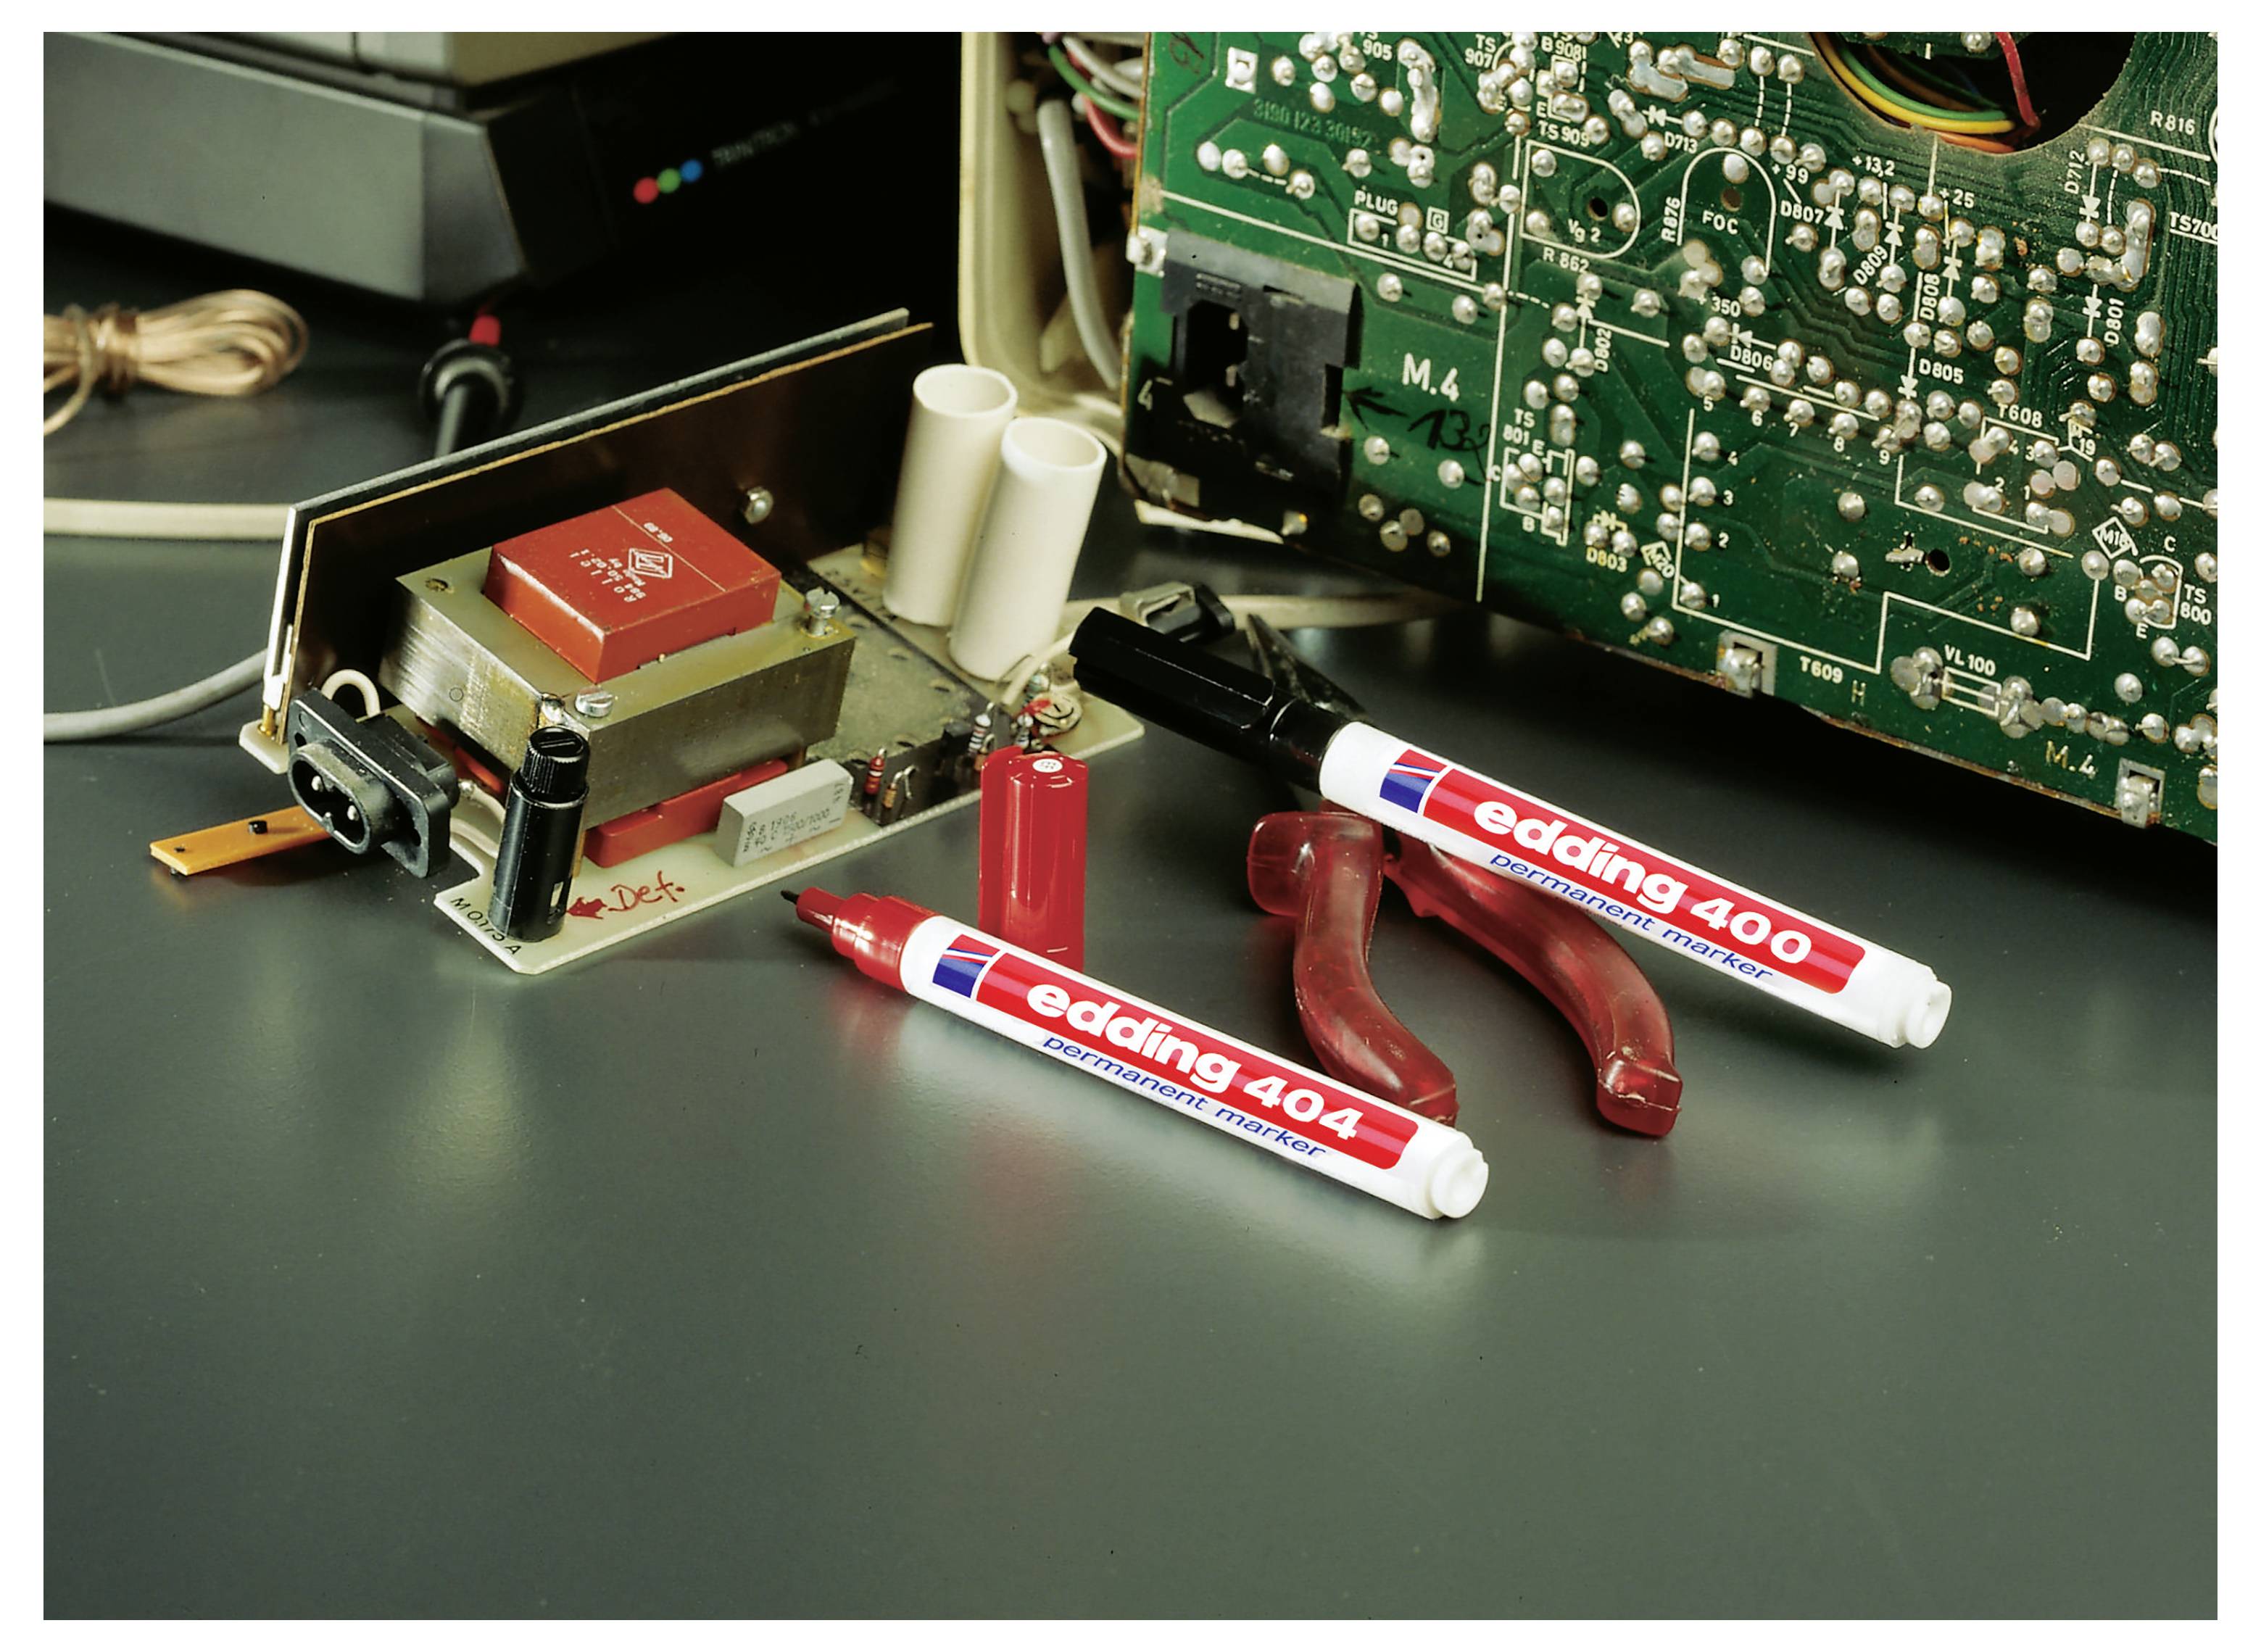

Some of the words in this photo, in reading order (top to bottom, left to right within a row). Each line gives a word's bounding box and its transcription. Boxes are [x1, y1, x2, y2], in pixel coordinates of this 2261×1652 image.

[1363, 38, 1393, 61] 905
[1476, 34, 1496, 54] TS
[1555, 40, 1582, 62] 908
[1465, 48, 1493, 70] 907
[1536, 101, 1546, 118] E
[1664, 130, 1698, 154] D713
[2065, 149, 2086, 194] D712
[1354, 189, 1398, 216] PLUG
[1780, 199, 1823, 225] D807
[1661, 196, 1681, 242] R876
[1702, 210, 1739, 236] FOC
[1382, 233, 1389, 248] 1
[1853, 244, 1888, 286] D809
[1920, 273, 1941, 321] D808
[2104, 298, 2125, 346] D801
[1595, 328, 1612, 373] D802
[1730, 344, 1774, 372] D806
[1401, 352, 1460, 402] M.4
[1919, 358, 1965, 385] D805
[1704, 396, 1714, 412] 5
[1998, 402, 2043, 428] T608
[1514, 407, 1535, 428] TS
[1751, 409, 1763, 427] 6
[1503, 424, 1530, 447] 801
[1790, 423, 1799, 437] 7
[1532, 439, 1545, 457] E
[1833, 436, 1845, 453] 8
[2009, 439, 2019, 455] 4
[2025, 445, 2035, 461] 3
[1727, 451, 1738, 466] 4
[1879, 449, 1890, 466] 9
[1995, 476, 2005, 493] 2
[2023, 485, 2031, 501] 1
[1723, 490, 1734, 506] 3
[1719, 532, 1730, 549] 2
[2164, 536, 2176, 552] C
[1585, 546, 1627, 573] D803
[2115, 585, 2127, 602] B
[2184, 584, 2207, 605] TS
[2180, 602, 2212, 626] 800
[2136, 622, 2146, 639] E
[1799, 655, 1844, 684] T609
[2045, 740, 2096, 780] M.4
[1474, 800, 1688, 915] edding
[1690, 897, 1812, 965] 400
[1489, 854, 1656, 932] permanent
[1661, 929, 1774, 981] marker
[505, 945, 521, 955] A
[1026, 983, 1241, 1094] edding
[1243, 1076, 1364, 1141] 404
[1042, 1036, 1208, 1111] permanent
[1214, 1105, 1325, 1158] marker
